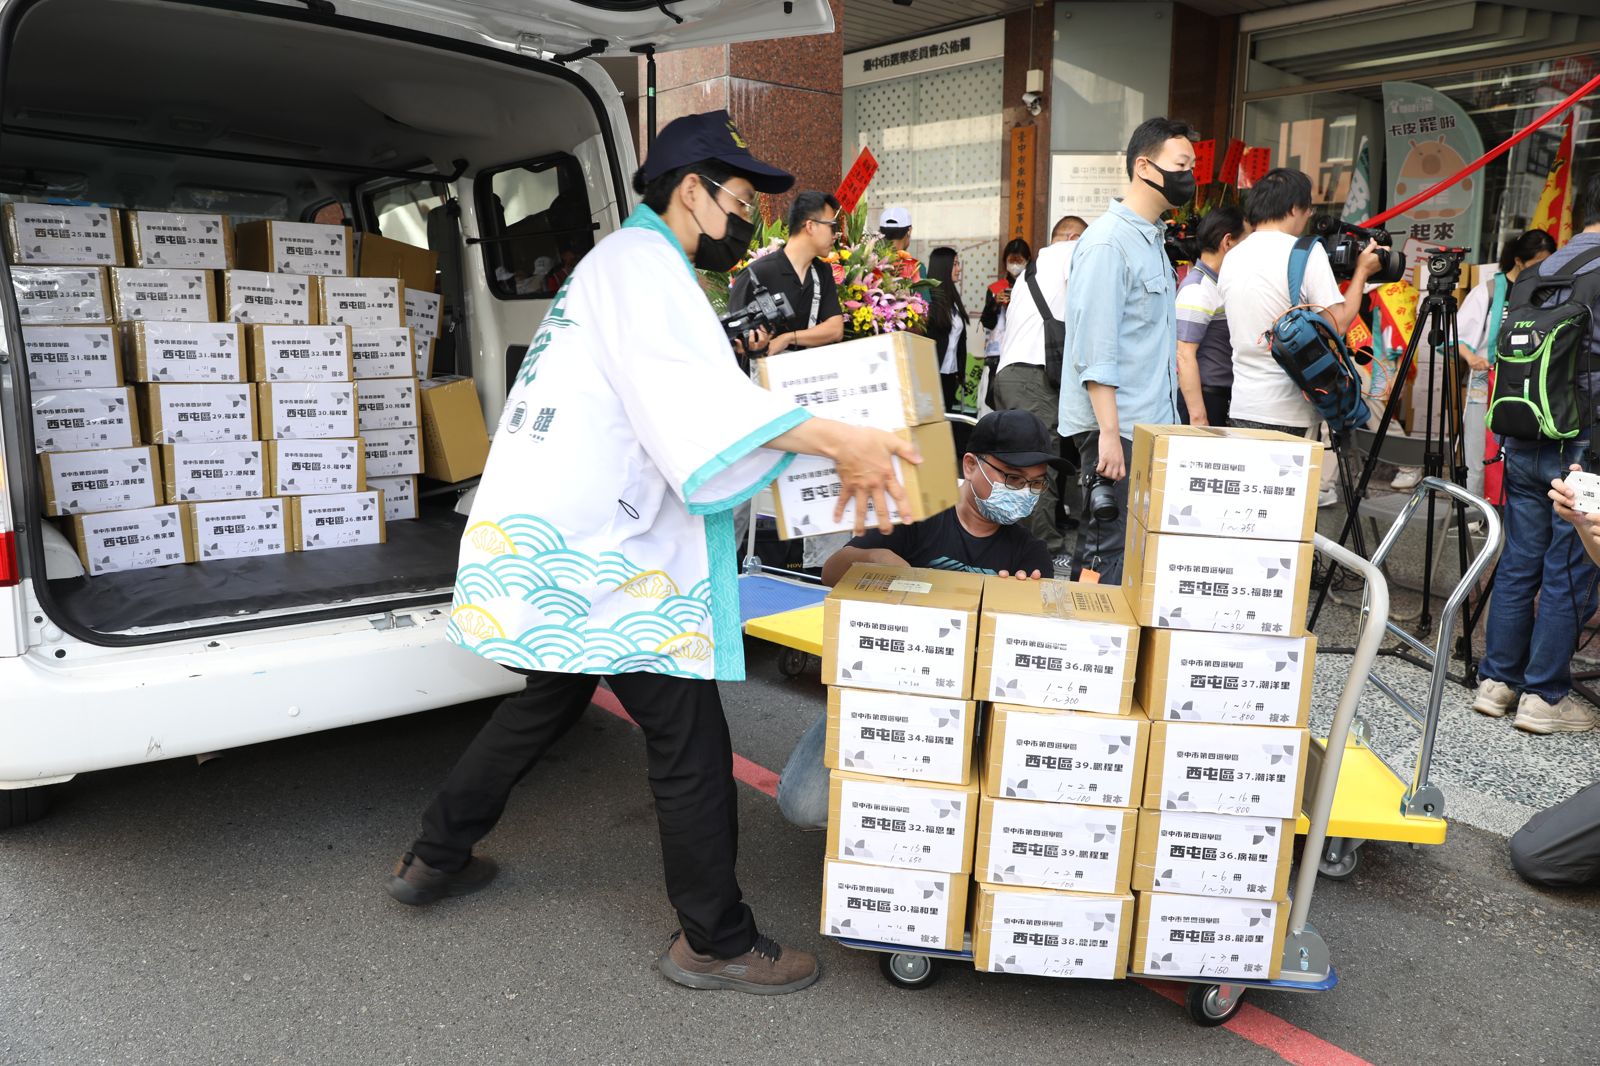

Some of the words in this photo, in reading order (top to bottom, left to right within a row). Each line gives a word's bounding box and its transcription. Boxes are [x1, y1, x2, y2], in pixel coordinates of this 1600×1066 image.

[863, 37, 971, 72] 臺中市選舉委員會公佈欄
[1388, 116, 1456, 136] 卡皮罷啦
[1389, 222, 1455, 240] 一起來
[1514, 320, 1536, 328] TVU
[191, 468, 256, 478] 西屯區27.港尾里
[71, 478, 145, 491] 西屯區27.港尾里
[1189, 477, 1296, 496] 西屯區35.福聯里
[315, 515, 374, 526] 西屯區26.惠來里
[213, 523, 278, 535] 西屯區26.惠來里
[103, 531, 175, 547] 西屯區26.惠來里
[166, 552, 180, 560] 複本
[1169, 564, 1233, 574] 臺中市第四選舉區
[1179, 580, 1283, 598] 西屯區35.福聯里
[849, 620, 908, 633] 臺中市第四選舉區
[1261, 622, 1283, 632] 複本
[859, 636, 954, 656] 西屯區34.福瑞里
[1015, 654, 1114, 674] 西屯區36.廣福里
[1180, 659, 1243, 668] 臺中市第四選舉區
[935, 678, 956, 688] 複本
[1190, 674, 1290, 690] 西屯區37.潮洋里
[851, 712, 908, 723] 臺中市第四選舉區
[1269, 713, 1290, 722] 複本
[860, 727, 954, 745] 西屯區34.福瑞里
[1016, 739, 1077, 750] 臺中市第四選舉區
[1176, 751, 1239, 761] 臺中市第四選舉區
[1025, 754, 1123, 772] 西屯區39.鵬程里
[1186, 766, 1286, 783] 西屯區37.潮洋里
[1102, 794, 1122, 803] 複本
[852, 802, 910, 813] 臺中市第四選舉區
[861, 816, 956, 835] 西屯區32.福恩里
[1003, 827, 1063, 838] 臺中市第四選舉區
[1161, 830, 1222, 840] 臺中市第四選舉區
[1012, 841, 1109, 860] 西屯區39.鵬程里
[1170, 845, 1268, 862] 西屯區36.廣福里
[838, 883, 894, 895] 臺中市第四選舉區
[1247, 884, 1267, 893] 複本
[847, 896, 938, 915] 西屯區30.福和里
[1004, 917, 1063, 928] 臺中市第四選舉區
[1160, 915, 1220, 924] 臺中市第四選舉區
[920, 934, 940, 944] 複本
[1013, 932, 1108, 947] 西屯區38.龍潭里
[1170, 929, 1264, 943] 西屯區38.龍潭里
[1243, 964, 1263, 972] 複本
